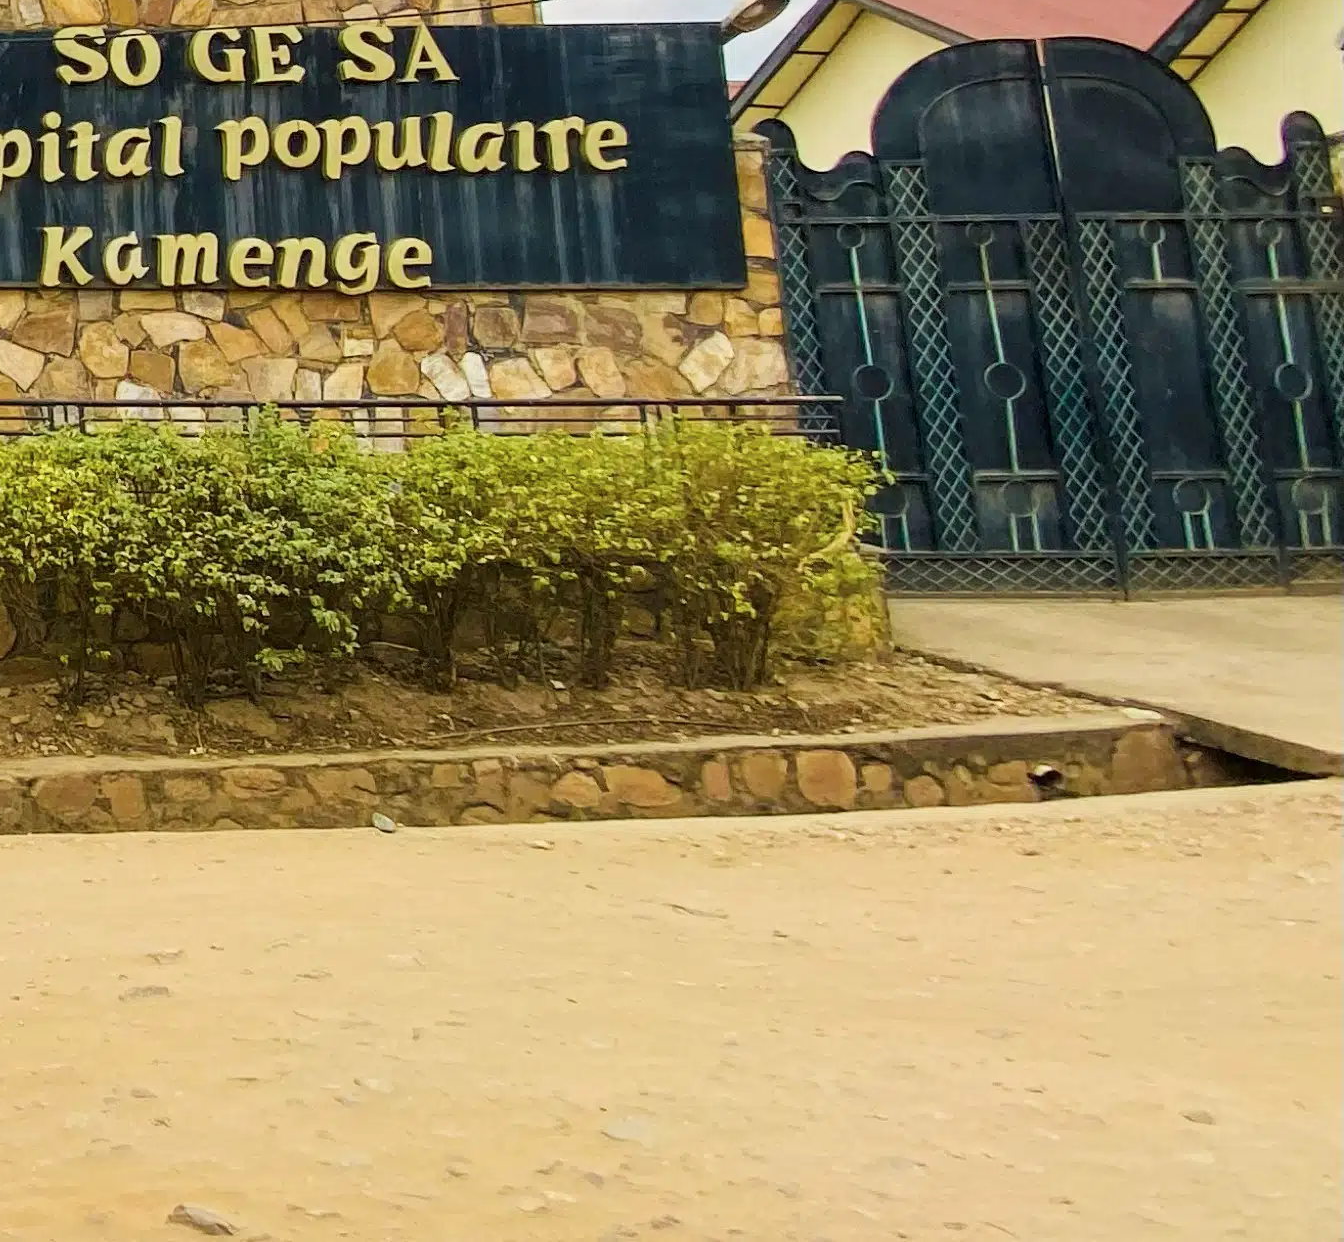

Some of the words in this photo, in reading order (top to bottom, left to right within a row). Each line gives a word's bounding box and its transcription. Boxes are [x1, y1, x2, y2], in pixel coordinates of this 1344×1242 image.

[53, 24, 162, 87] SO
[187, 27, 307, 85] GE
[338, 21, 461, 85] SA
[214, 110, 629, 182] populaire
[41, 225, 433, 295] Kamenge
